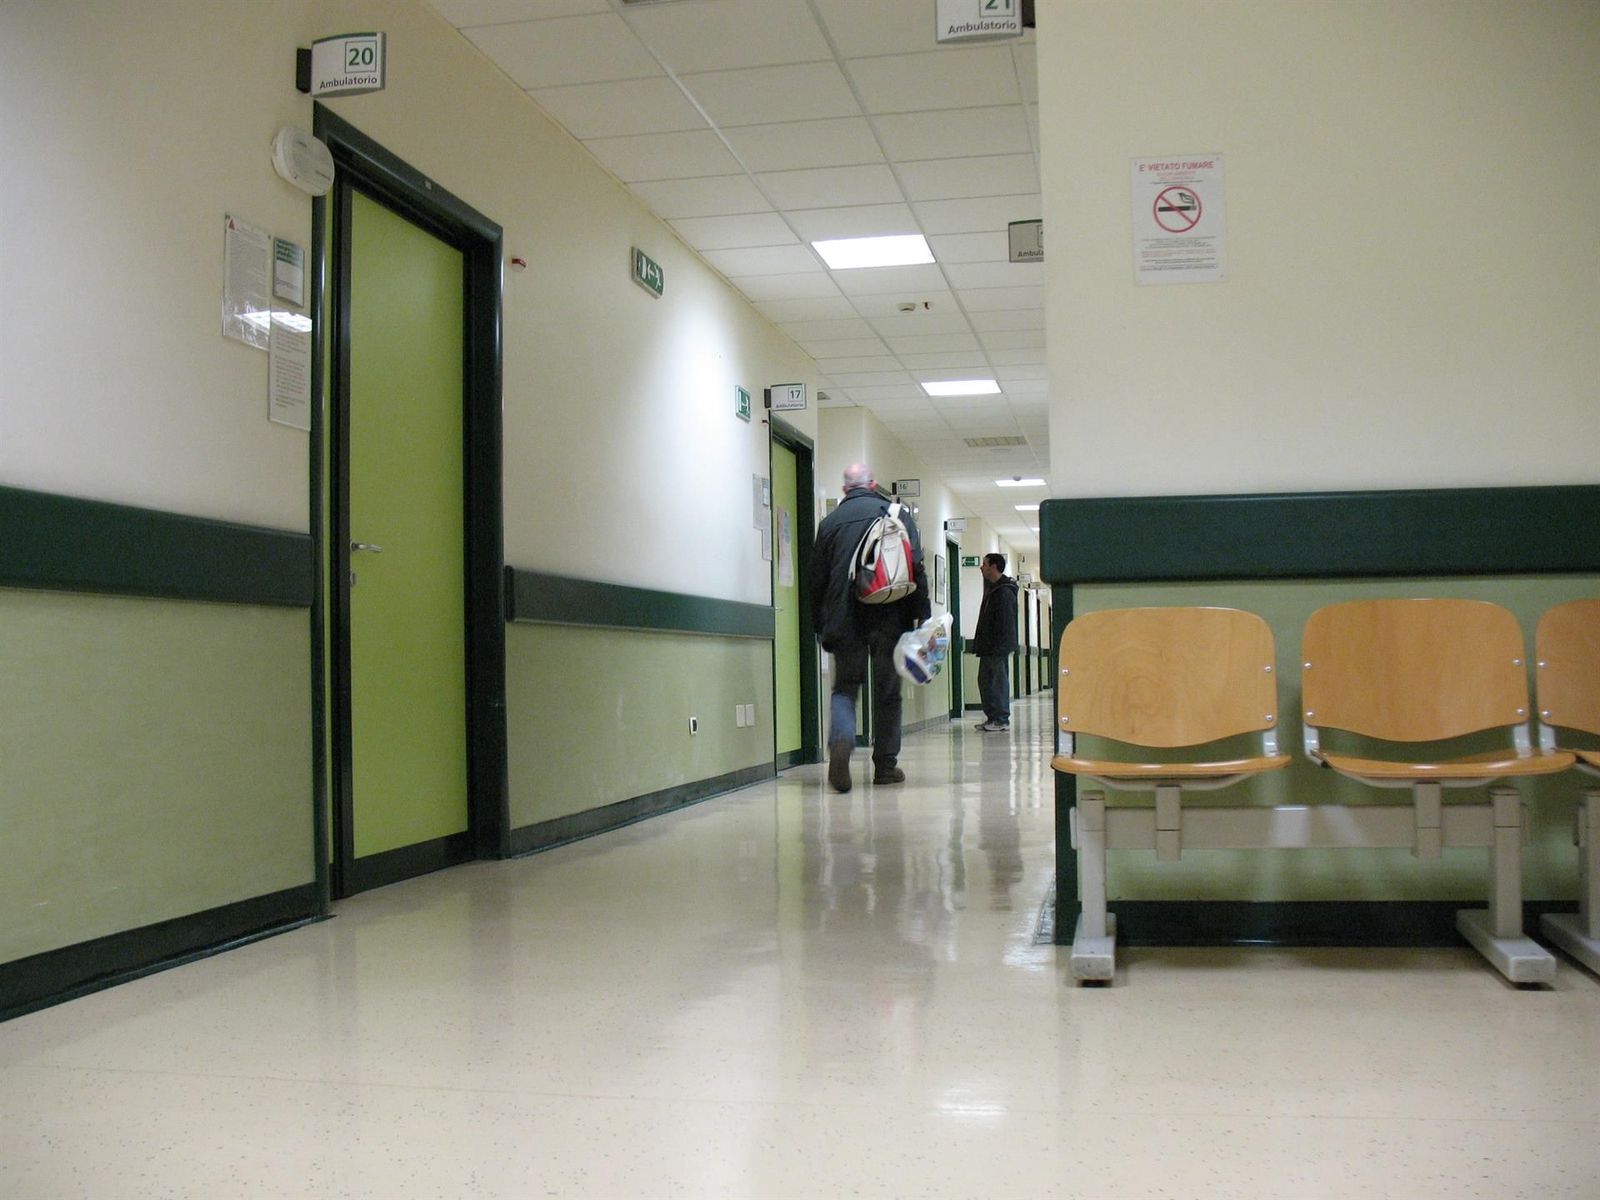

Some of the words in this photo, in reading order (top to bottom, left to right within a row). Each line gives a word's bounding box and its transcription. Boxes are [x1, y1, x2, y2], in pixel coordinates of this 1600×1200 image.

[985, 0, 1010, 10] 21
[948, 20, 1017, 34] Ambulatorio
[348, 47, 374, 66] 20
[319, 75, 378, 90] Ambulatorio
[1148, 162, 1181, 171] VIETATO
[1182, 160, 1214, 170] FUMARE
[790, 389, 801, 399] 17
